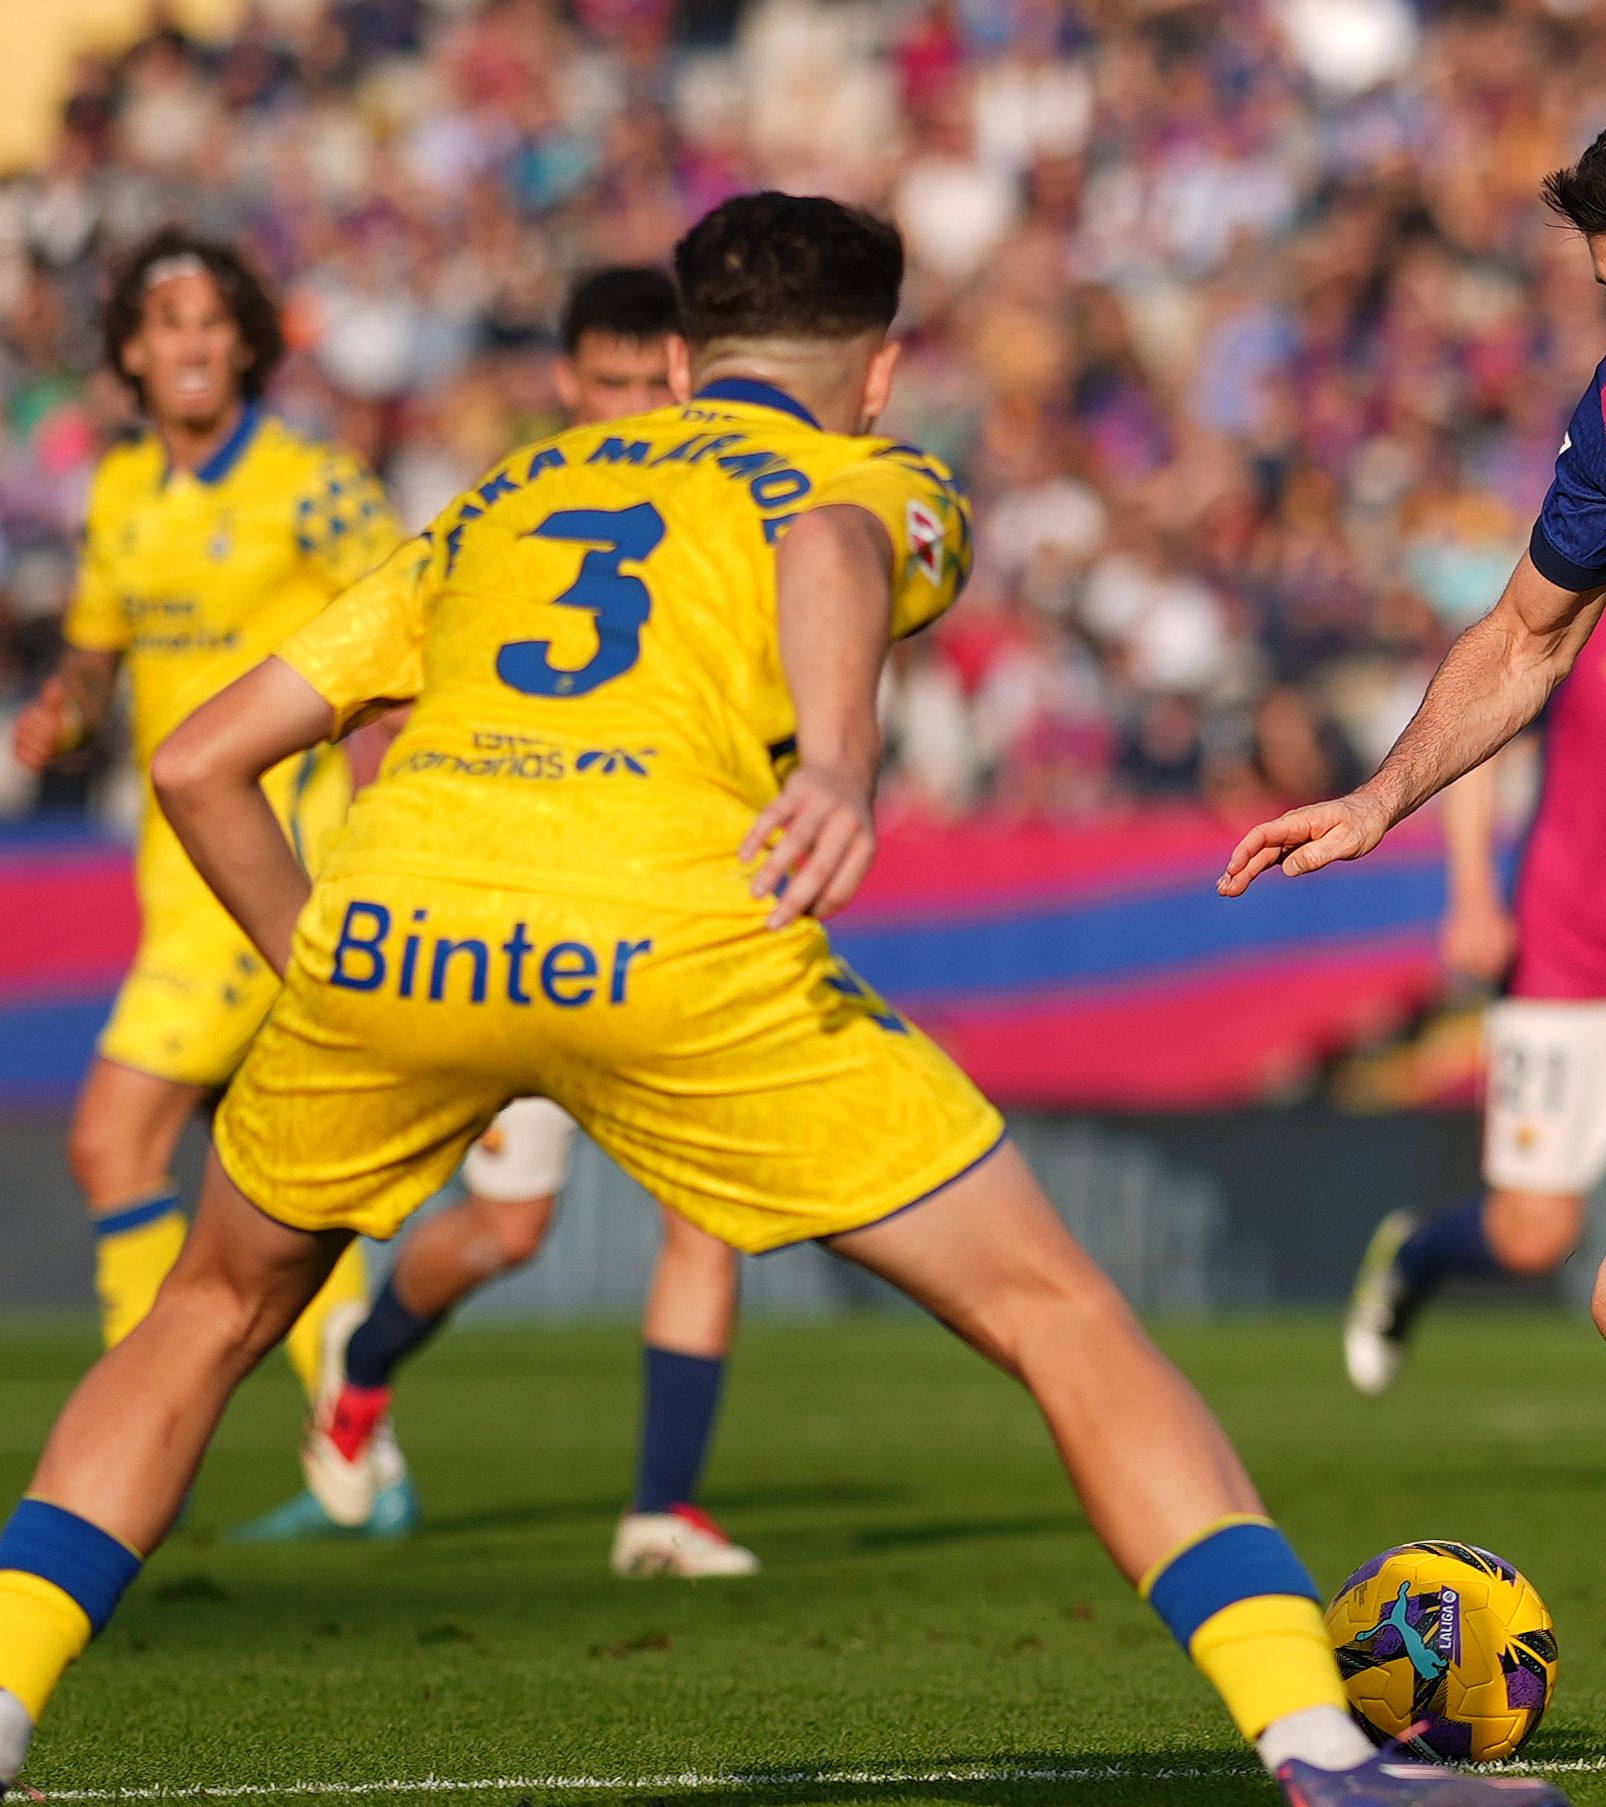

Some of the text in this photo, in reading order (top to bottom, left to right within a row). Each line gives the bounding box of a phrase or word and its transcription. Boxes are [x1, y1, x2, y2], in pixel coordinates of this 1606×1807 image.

[496, 502, 665, 697] 3
[329, 900, 652, 1006] Binter
[1438, 1605, 1455, 1650] LALIGA
